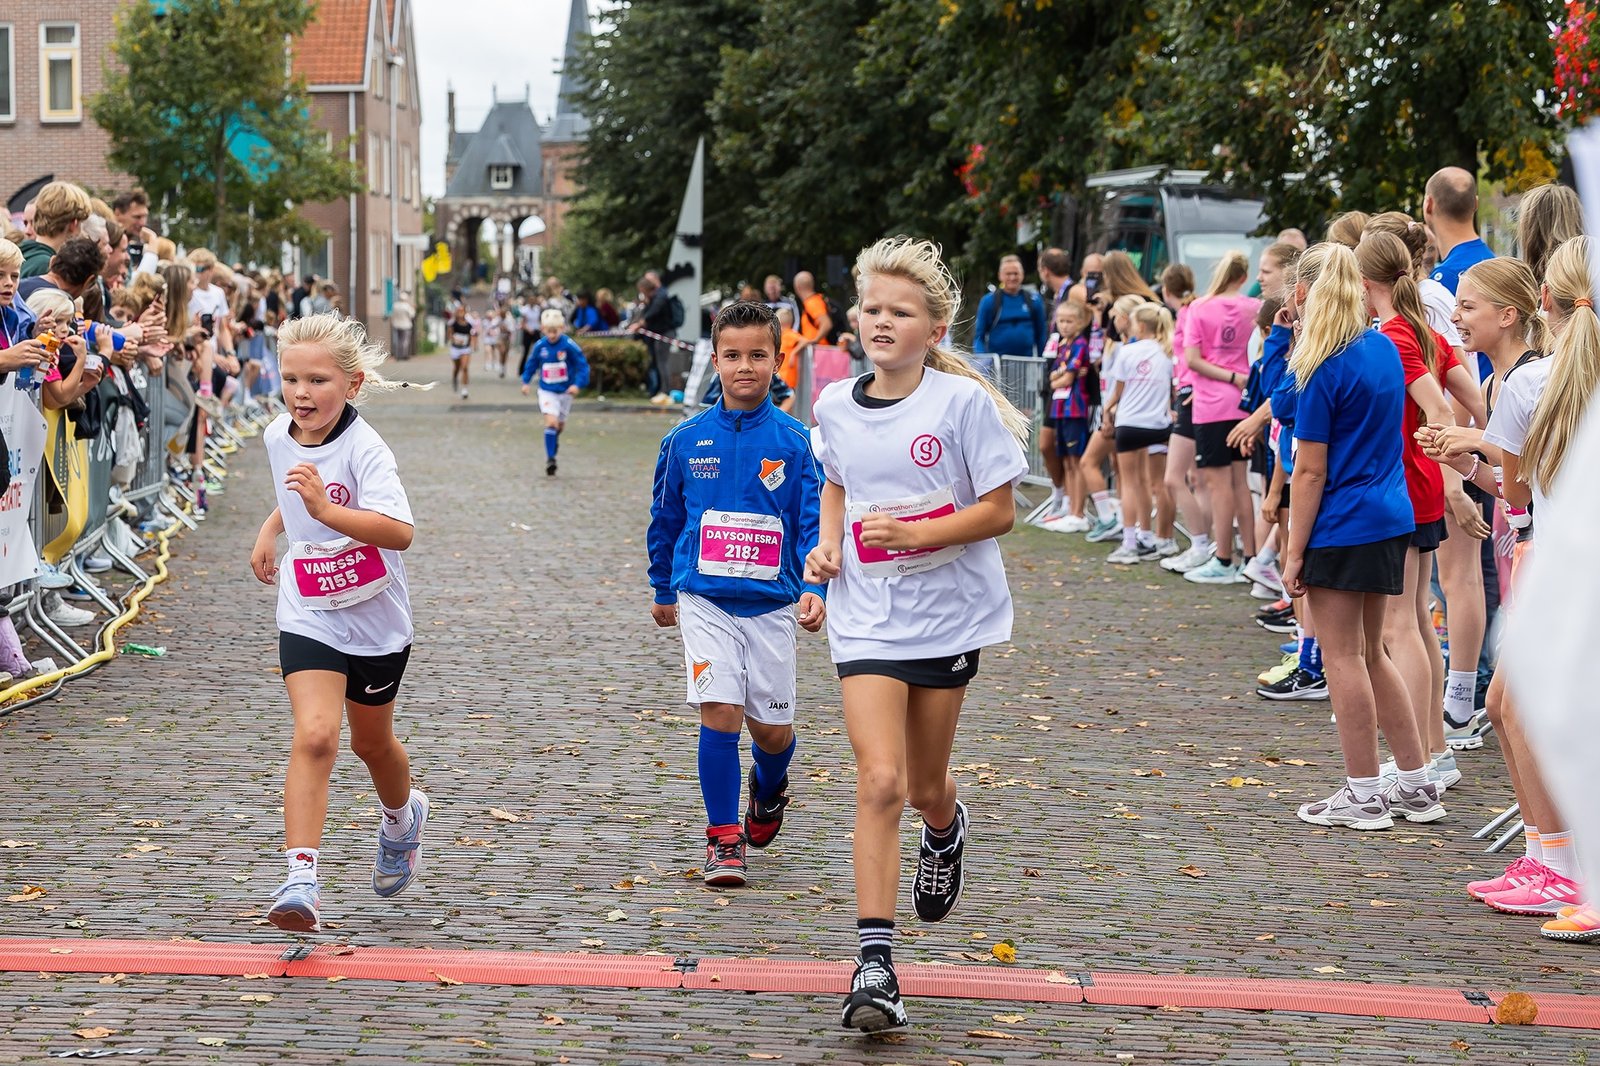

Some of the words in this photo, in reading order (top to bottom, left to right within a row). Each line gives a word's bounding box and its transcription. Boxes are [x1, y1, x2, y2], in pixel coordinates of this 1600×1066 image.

[706, 530, 753, 542] DAYSON
[754, 533, 778, 545] ESRA
[724, 543, 760, 560] 2182
[303, 550, 366, 574] VANESSA
[318, 568, 358, 592] 2155
[768, 701, 789, 710] JAKO
